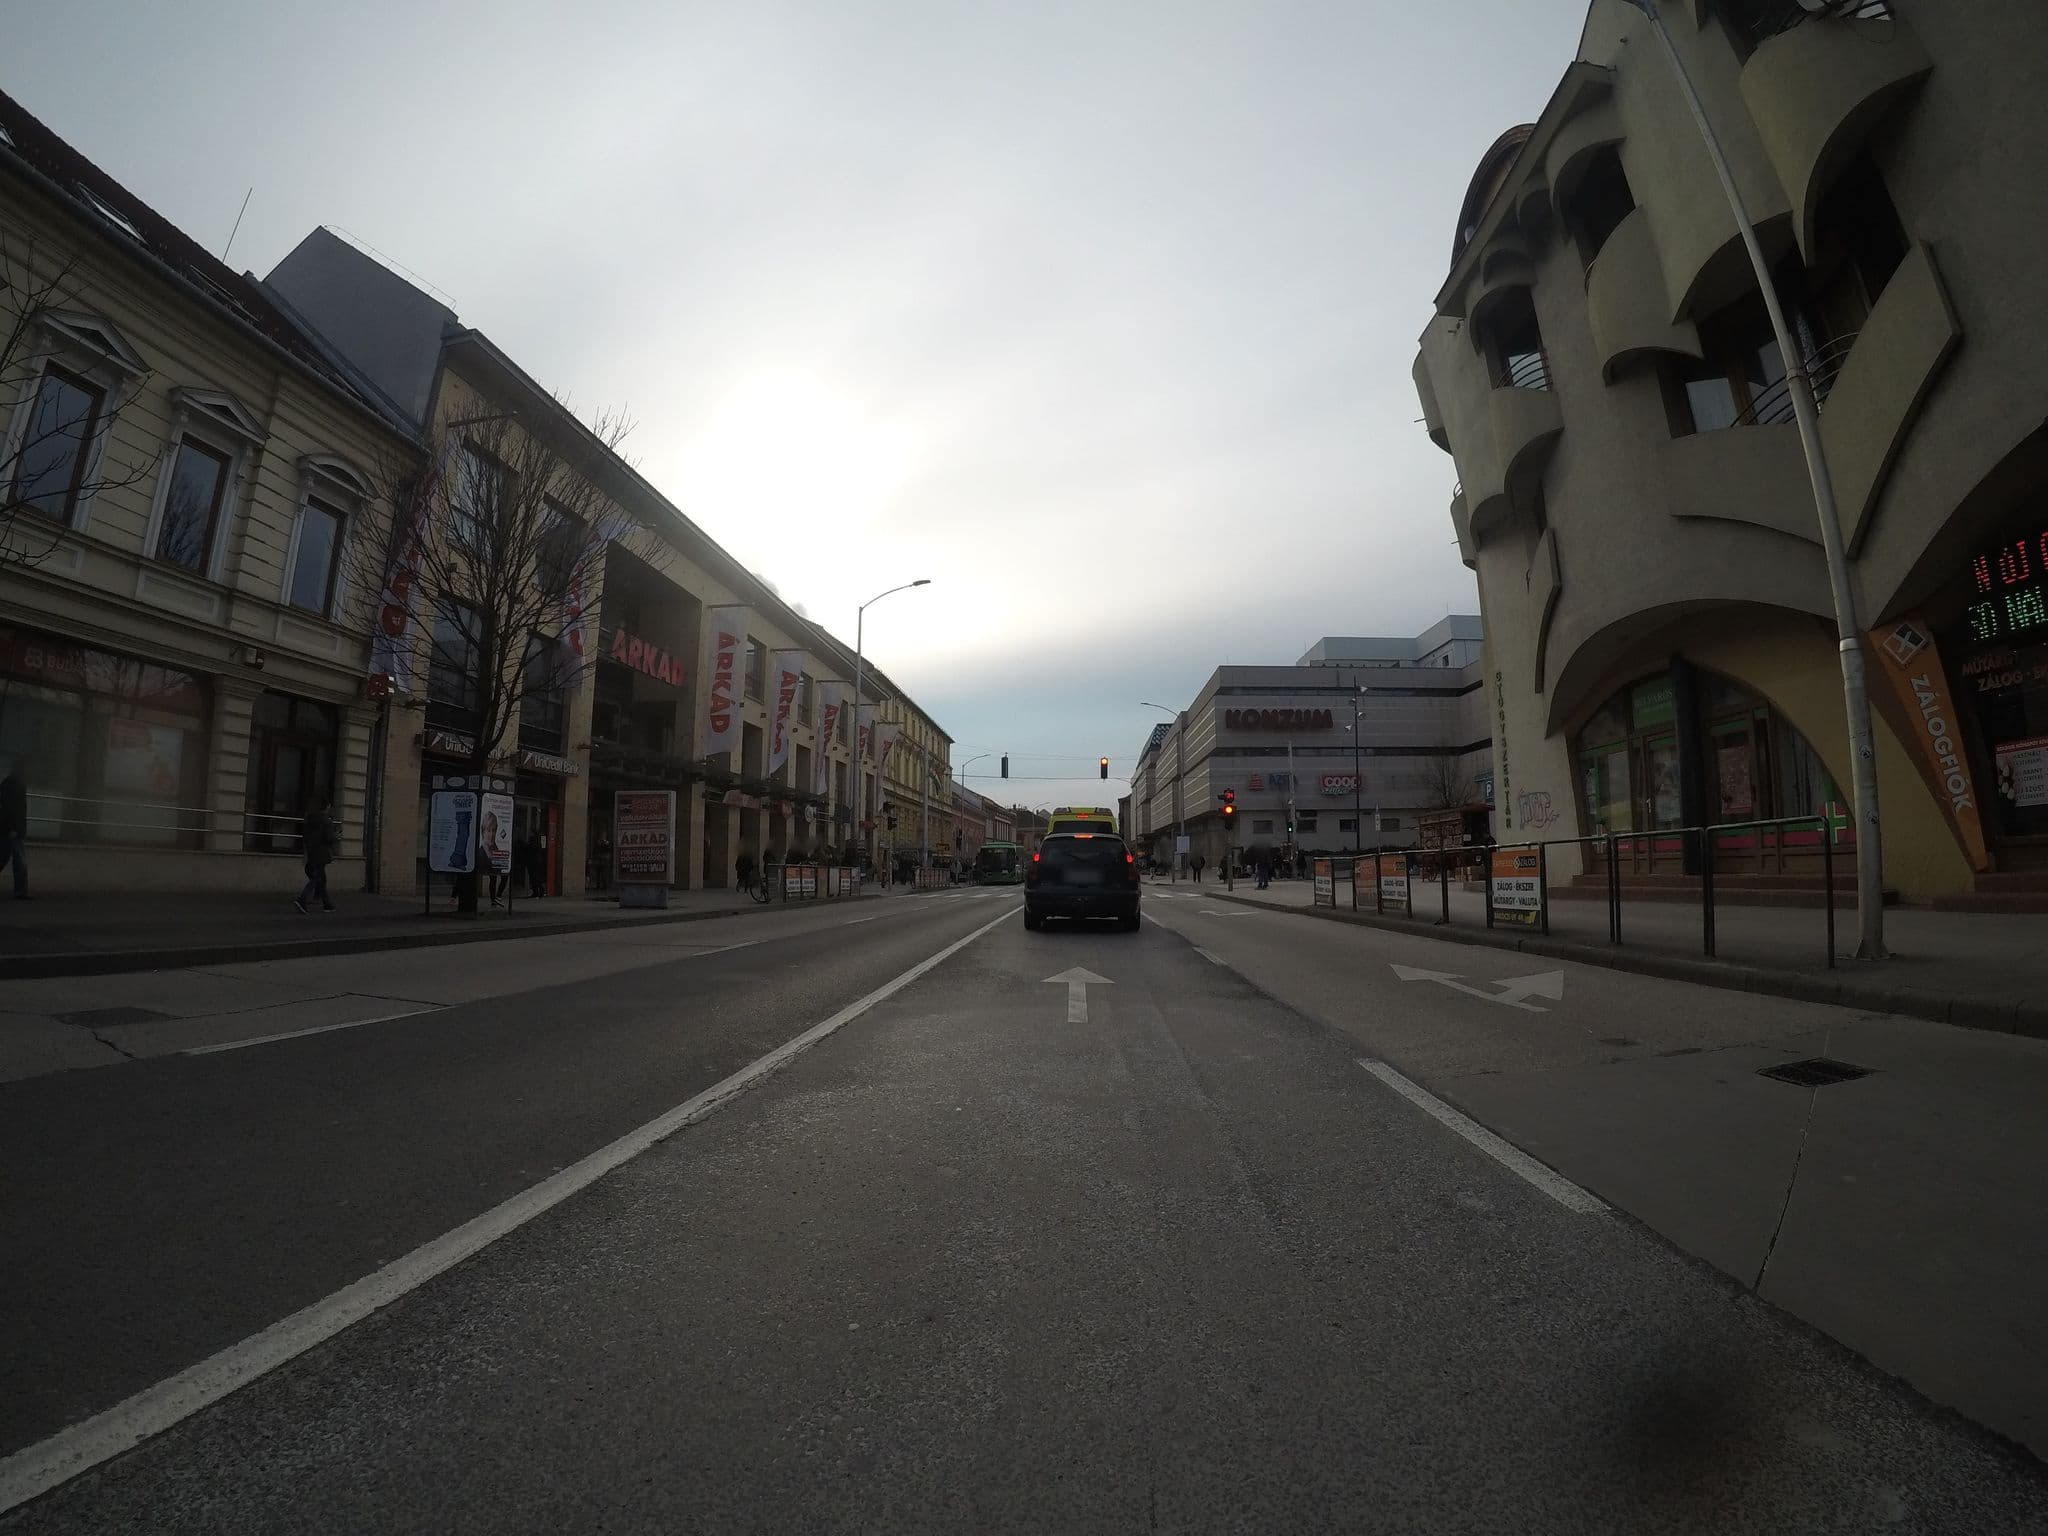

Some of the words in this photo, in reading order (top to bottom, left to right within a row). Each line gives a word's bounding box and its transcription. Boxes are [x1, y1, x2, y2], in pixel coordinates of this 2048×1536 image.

[709, 631, 740, 734] ÁRKÁD
[1225, 708, 1334, 729] KONZUM
[1909, 673, 1974, 816] ZÁLOGFIÓK
[1497, 880, 1513, 891] ZÁLOG
[1515, 880, 1534, 891] ÉKSZER
